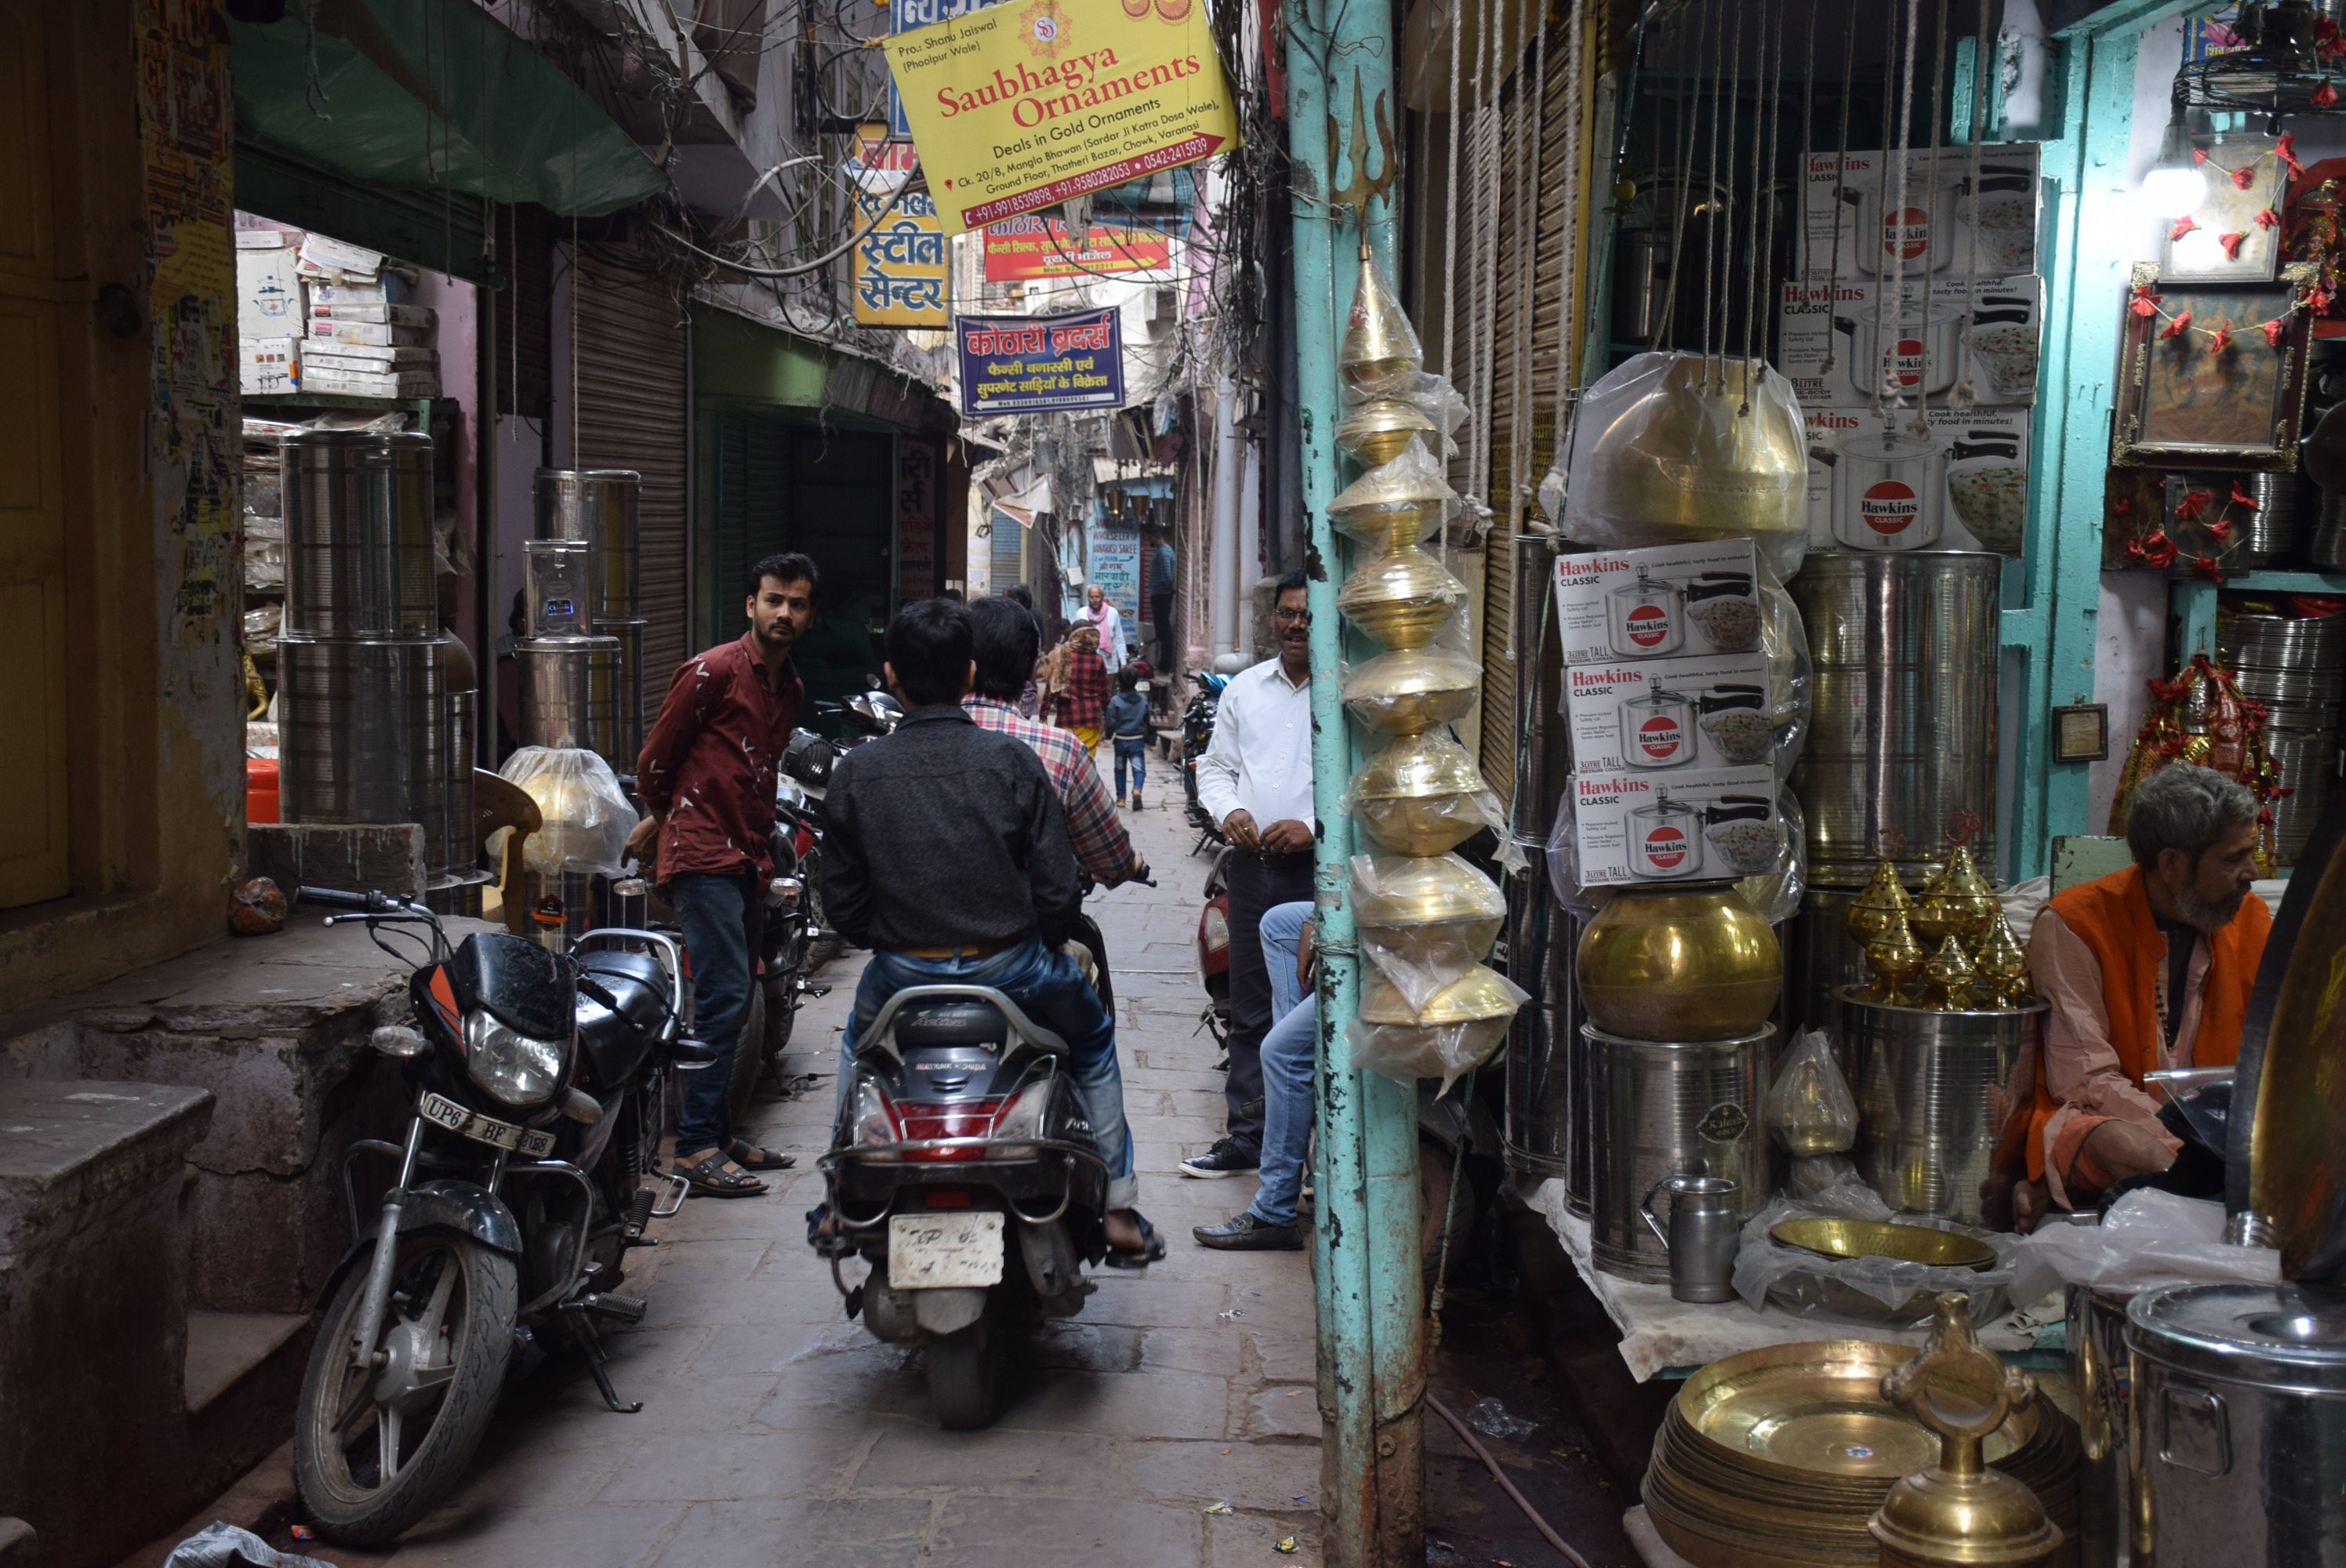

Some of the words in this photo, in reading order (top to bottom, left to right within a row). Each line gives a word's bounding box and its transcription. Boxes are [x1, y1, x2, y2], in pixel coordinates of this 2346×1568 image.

[898, 45, 922, 57] Pro.:
[924, 34, 957, 50] Shanu
[959, 18, 997, 40] Jaiswal
[902, 51, 948, 74] (Phoolpur
[949, 40, 981, 57] Wale)
[937, 47, 1119, 118] Saubhagya
[1012, 54, 1200, 128] Ornaments
[993, 138, 1032, 159] Deals
[1033, 134, 1048, 147] in
[1050, 119, 1084, 141] Gold
[1088, 98, 1160, 129] Ornaments
[957, 176, 975, 188] Ck.
[975, 167, 1005, 183] 20/8,
[1007, 156, 1043, 173] Mangla
[1044, 143, 1082, 162] Bhawan
[1084, 131, 1120, 151] (Sardar
[1123, 125, 1130, 138] Ji
[1132, 120, 1159, 134] Katra
[1160, 111, 1185, 125] Dosa
[1186, 100, 1219, 116] Wale),
[986, 177, 1022, 194] Ground
[1023, 169, 1050, 184] Floor,
[1051, 154, 1089, 174] Thatheri
[1091, 147, 1122, 162] Bazar,
[1123, 134, 1157, 151] Chowk,
[1157, 120, 1200, 140] Varanasi
[1055, 162, 1131, 195] +91-9580282053
[1144, 136, 1208, 169] 0542-2415939
[860, 220, 944, 266] स्टील
[858, 263, 946, 312] सेन्टर
[1933, 288, 1952, 296] tasty
[966, 318, 1046, 356] कोठारी
[1050, 312, 1110, 358] ब्रदर्स
[987, 360, 1023, 376] फैन्सी
[1026, 358, 1073, 374] बनारसी
[1075, 356, 1095, 372] एवं
[977, 379, 1017, 400] सुपरनेट
[1019, 376, 1056, 396] साड़ियों
[1058, 375, 1070, 390] के
[1073, 373, 1108, 389] विक्रेता
[1803, 412, 1859, 429] wkins
[1953, 409, 1998, 418] healthful,
[1861, 499, 1918, 514] Hawkins
[1874, 516, 1905, 524] CLASSIC
[1560, 557, 1630, 577] Hawkins
[1560, 575, 1600, 587] CLASSIC
[1626, 619, 1669, 633] Hawkins
[1637, 630, 1660, 639] CLASSIC
[1589, 645, 1610, 658] TALL
[1572, 668, 1643, 687] Hawkins
[1574, 686, 1613, 697] CLASSIC
[1638, 731, 1681, 744] Hawkins
[1601, 756, 1622, 768] TALL
[1579, 777, 1649, 796] Hawkins
[1580, 796, 1620, 806] CLASSIC
[1645, 841, 1687, 853] Hawkins
[1607, 866, 1628, 877] TALL
[483, 1123, 507, 1142] BF
